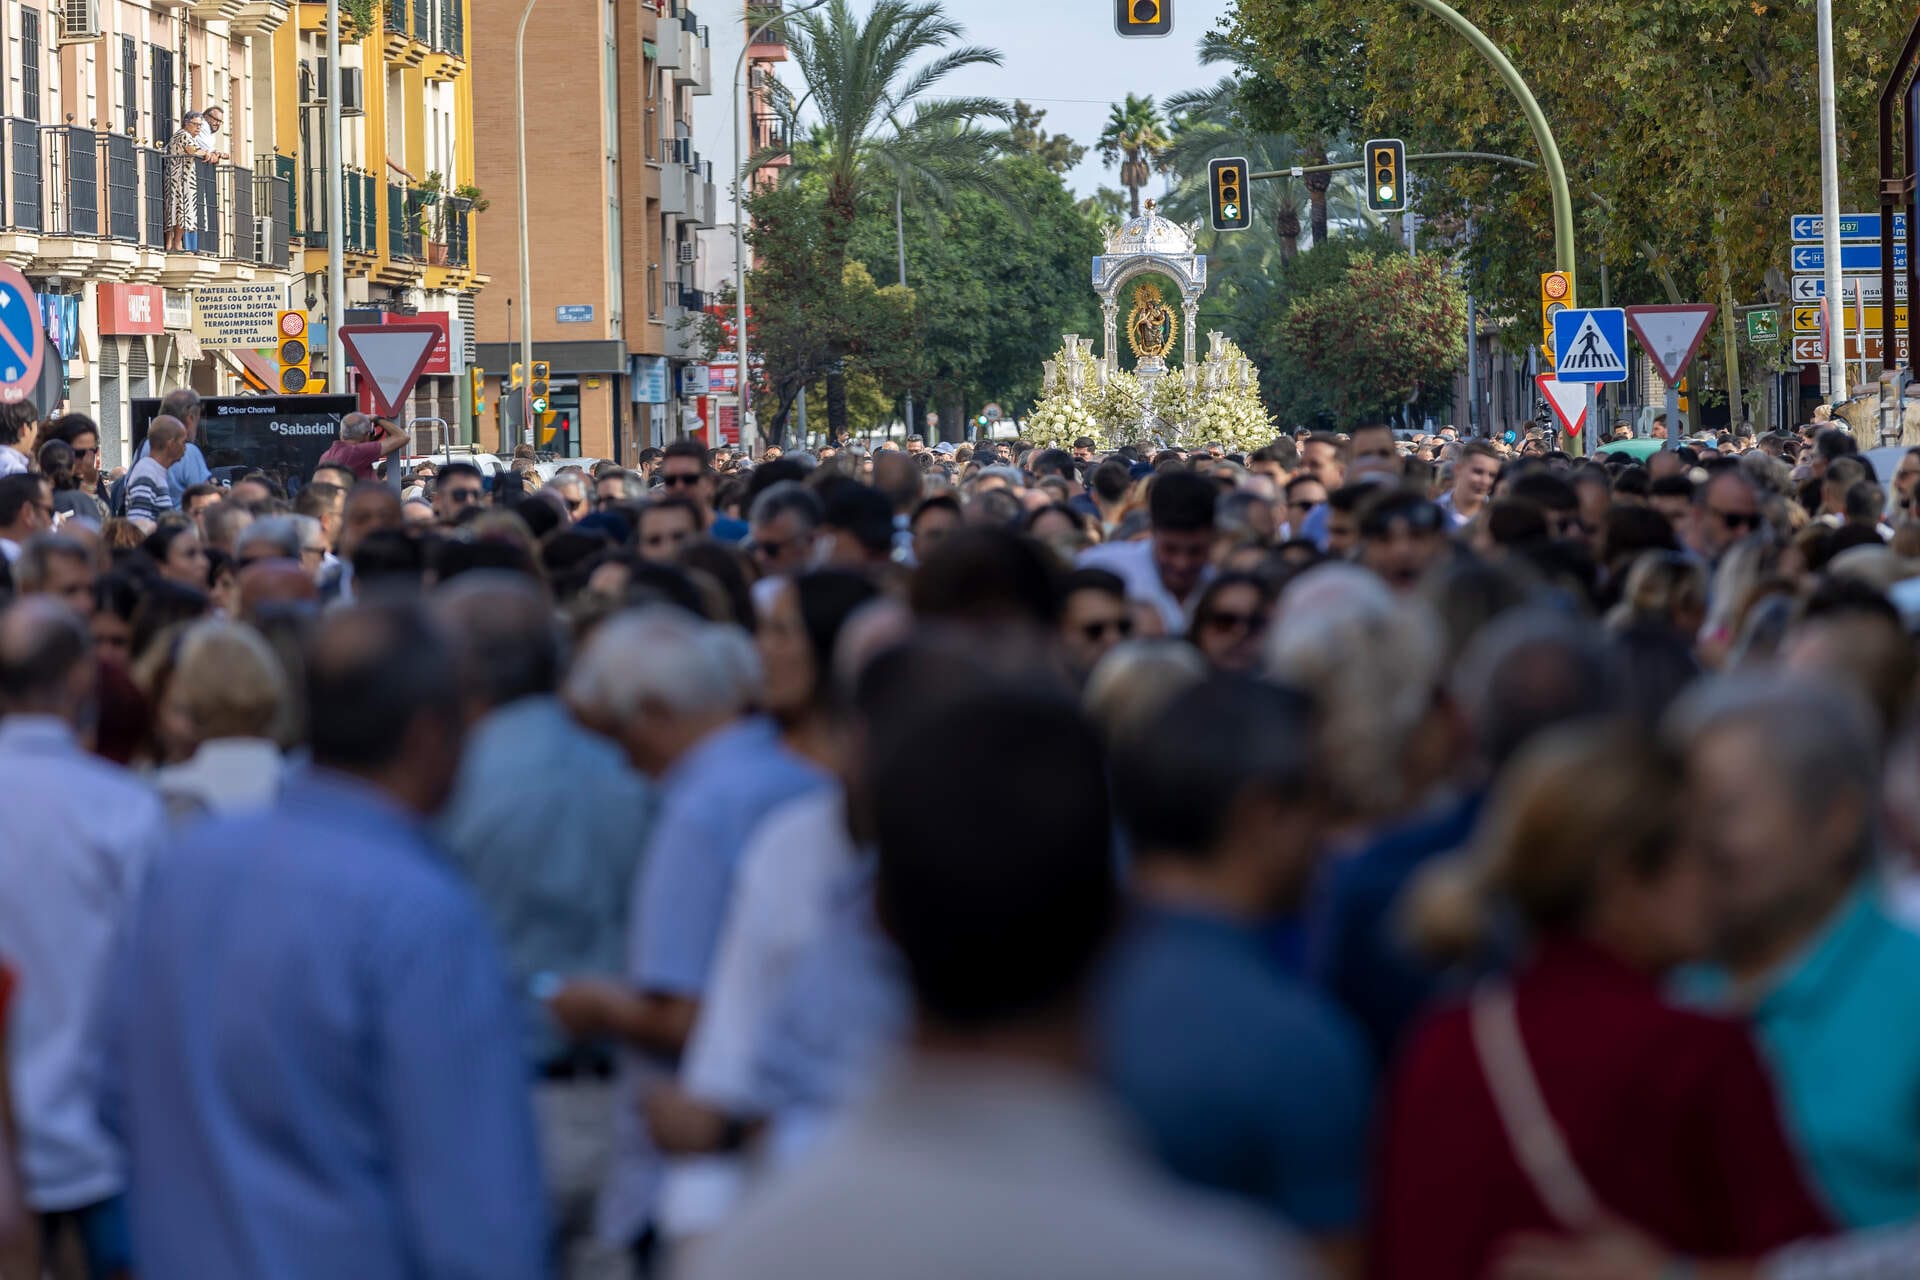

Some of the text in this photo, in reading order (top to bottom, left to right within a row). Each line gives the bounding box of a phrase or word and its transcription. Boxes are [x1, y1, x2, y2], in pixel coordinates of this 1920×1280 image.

[199, 303, 242, 311] IMPRESION
[203, 311, 273, 319] ENCUADERNACION
[204, 319, 273, 327] TERMOIMPRESION
[228, 406, 276, 414] Clear Channel
[280, 422, 334, 435] Sabadell
